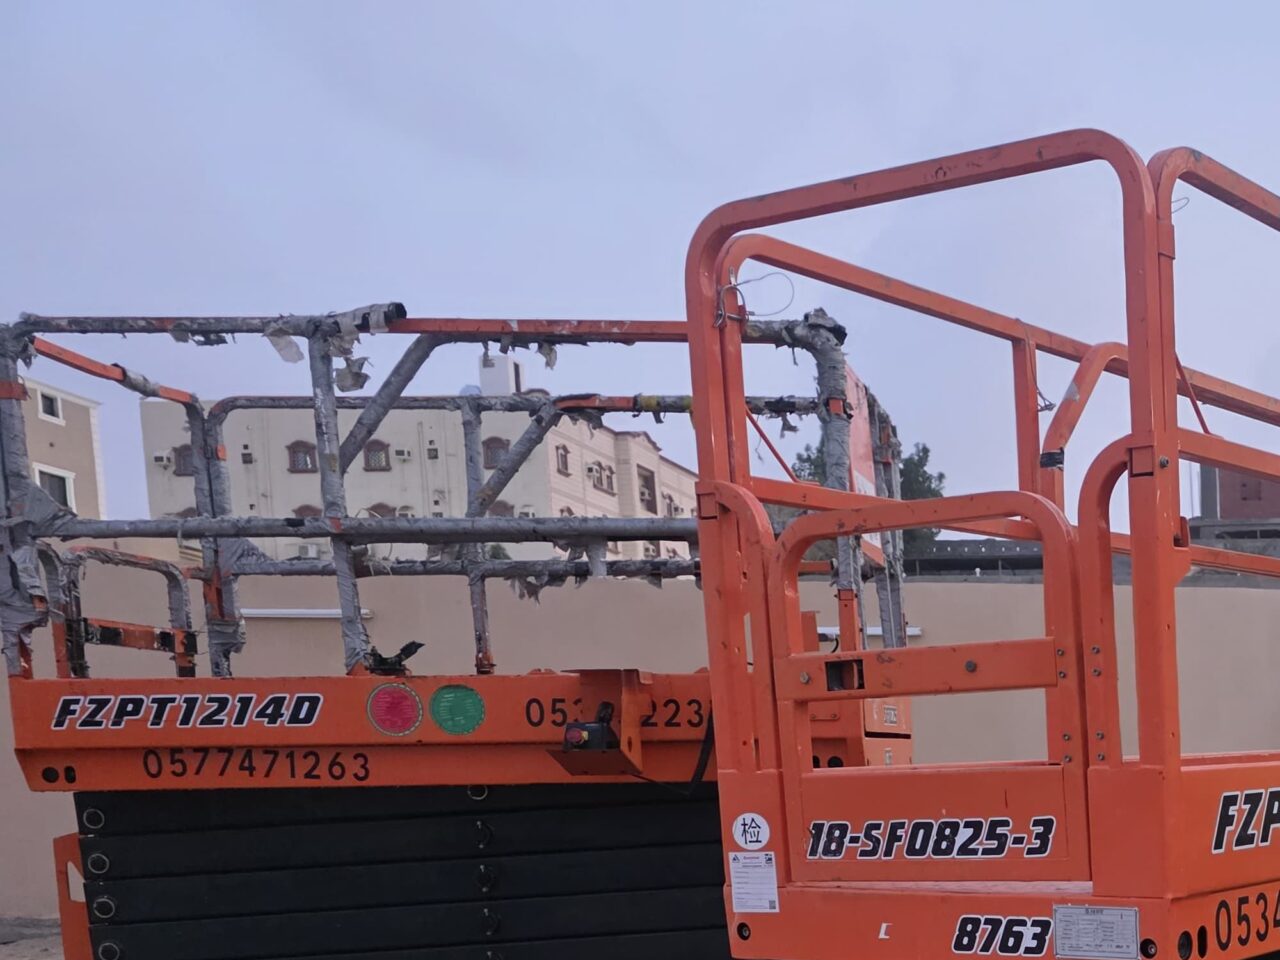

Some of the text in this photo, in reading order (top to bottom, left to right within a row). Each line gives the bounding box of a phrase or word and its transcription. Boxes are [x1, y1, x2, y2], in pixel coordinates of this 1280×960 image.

[143, 750, 370, 781] 0577471263
[741, 817, 762, 845] 检
[807, 816, 1056, 860] 18-SF0825-3
[952, 914, 1054, 956] 8763
